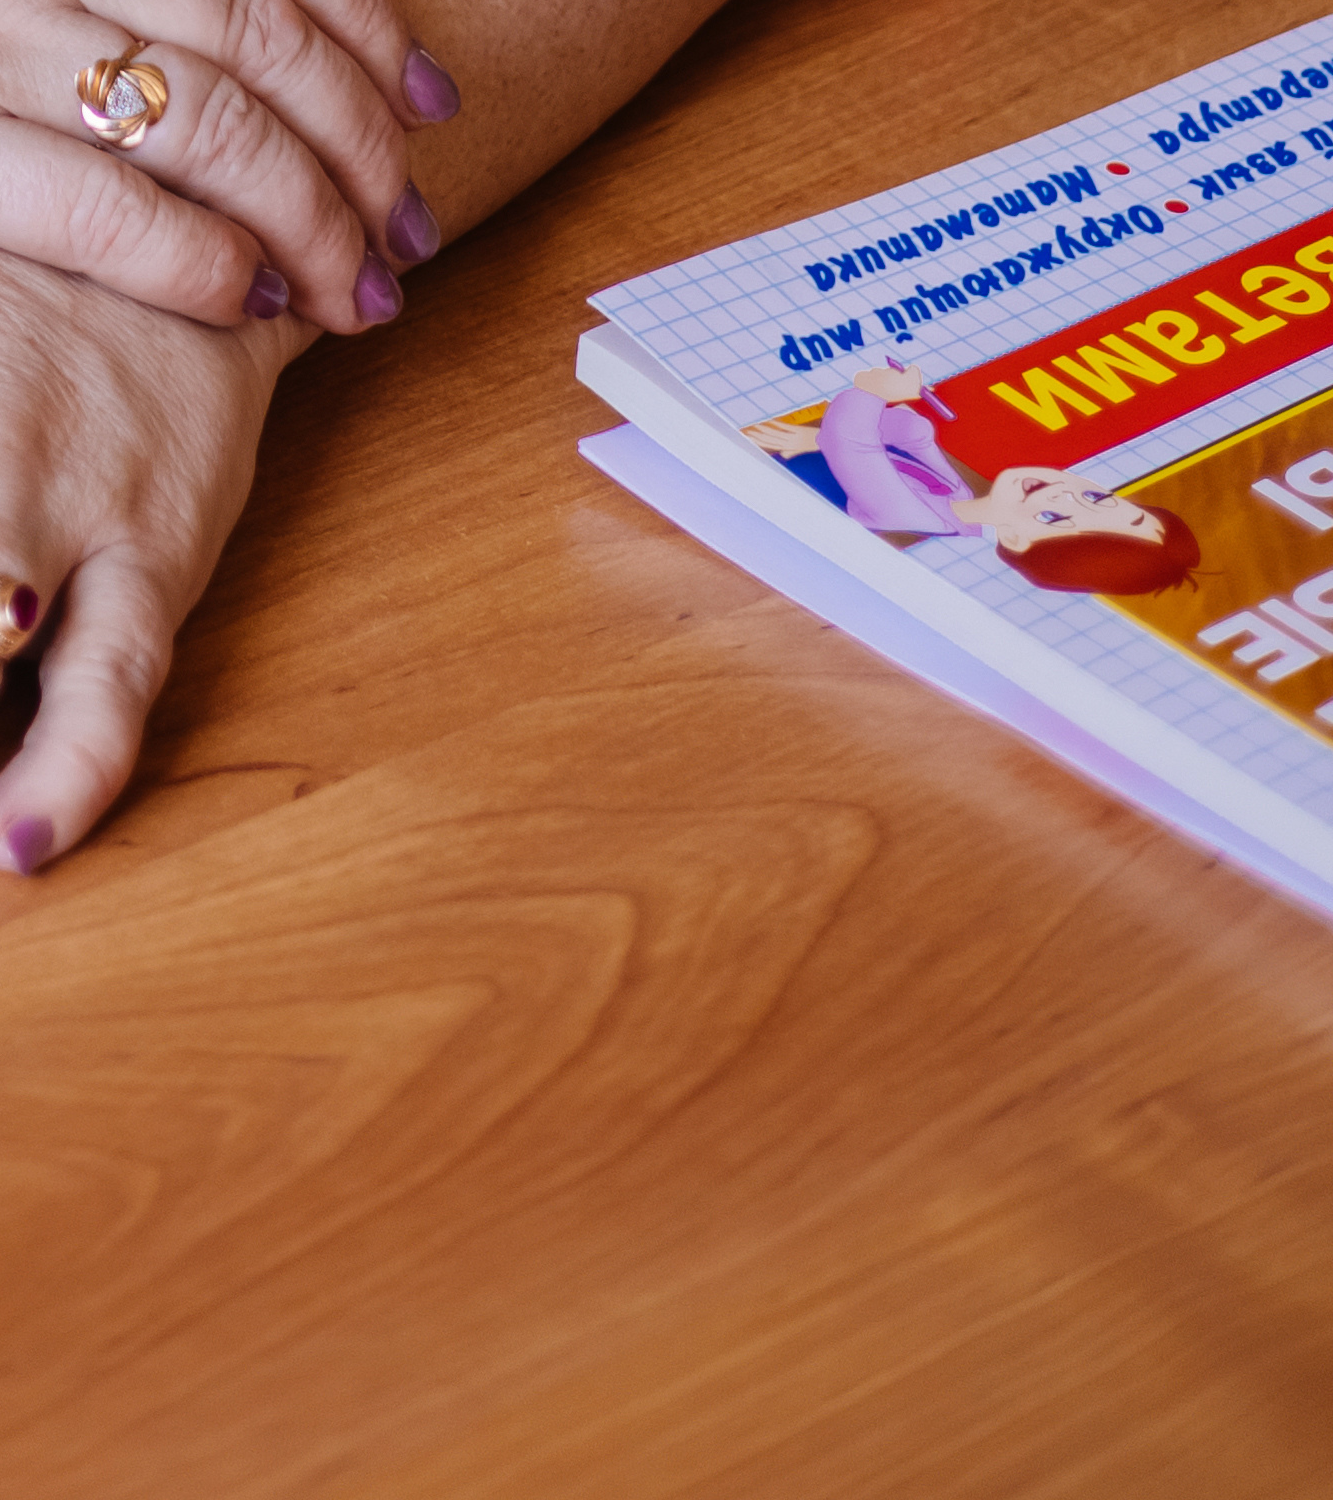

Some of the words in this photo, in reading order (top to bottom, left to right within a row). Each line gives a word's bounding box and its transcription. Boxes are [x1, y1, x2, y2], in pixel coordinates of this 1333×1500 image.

[1147, 57, 1333, 157] ература
[1186, 139, 1299, 203] язык
[802, 163, 1102, 293] Математика
[871, 203, 1166, 346] Окружающий
[777, 317, 866, 375] мир
